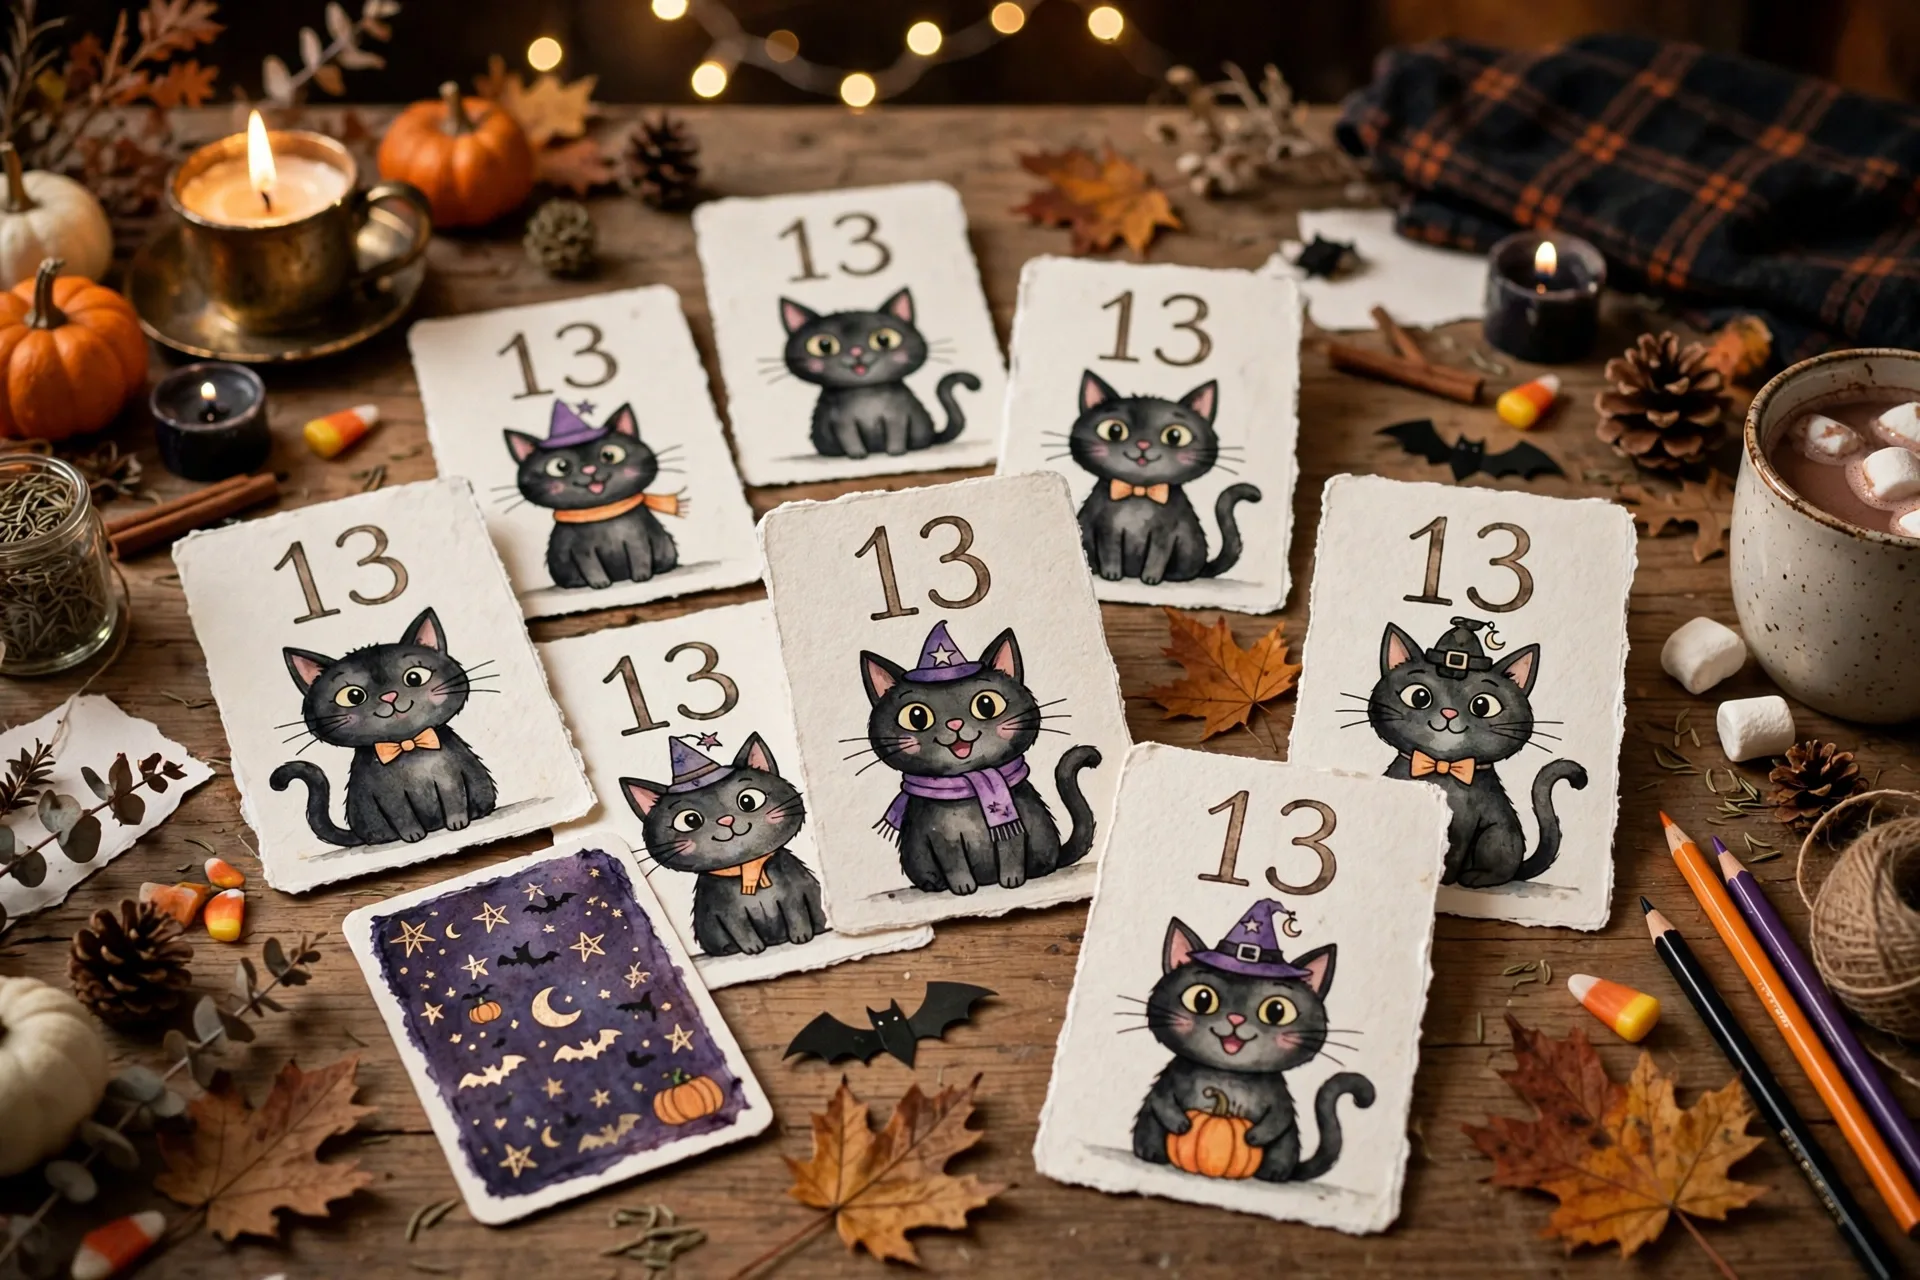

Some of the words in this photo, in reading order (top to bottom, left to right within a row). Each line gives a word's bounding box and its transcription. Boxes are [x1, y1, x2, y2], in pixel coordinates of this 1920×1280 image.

[778, 211, 894, 282] 13
[497, 321, 620, 401] 13
[1097, 289, 1215, 367] 13
[272, 524, 409, 625] 13
[854, 514, 992, 622] 13
[1402, 515, 1535, 614] 13
[601, 640, 741, 738] 13
[1196, 789, 1338, 897] 13
